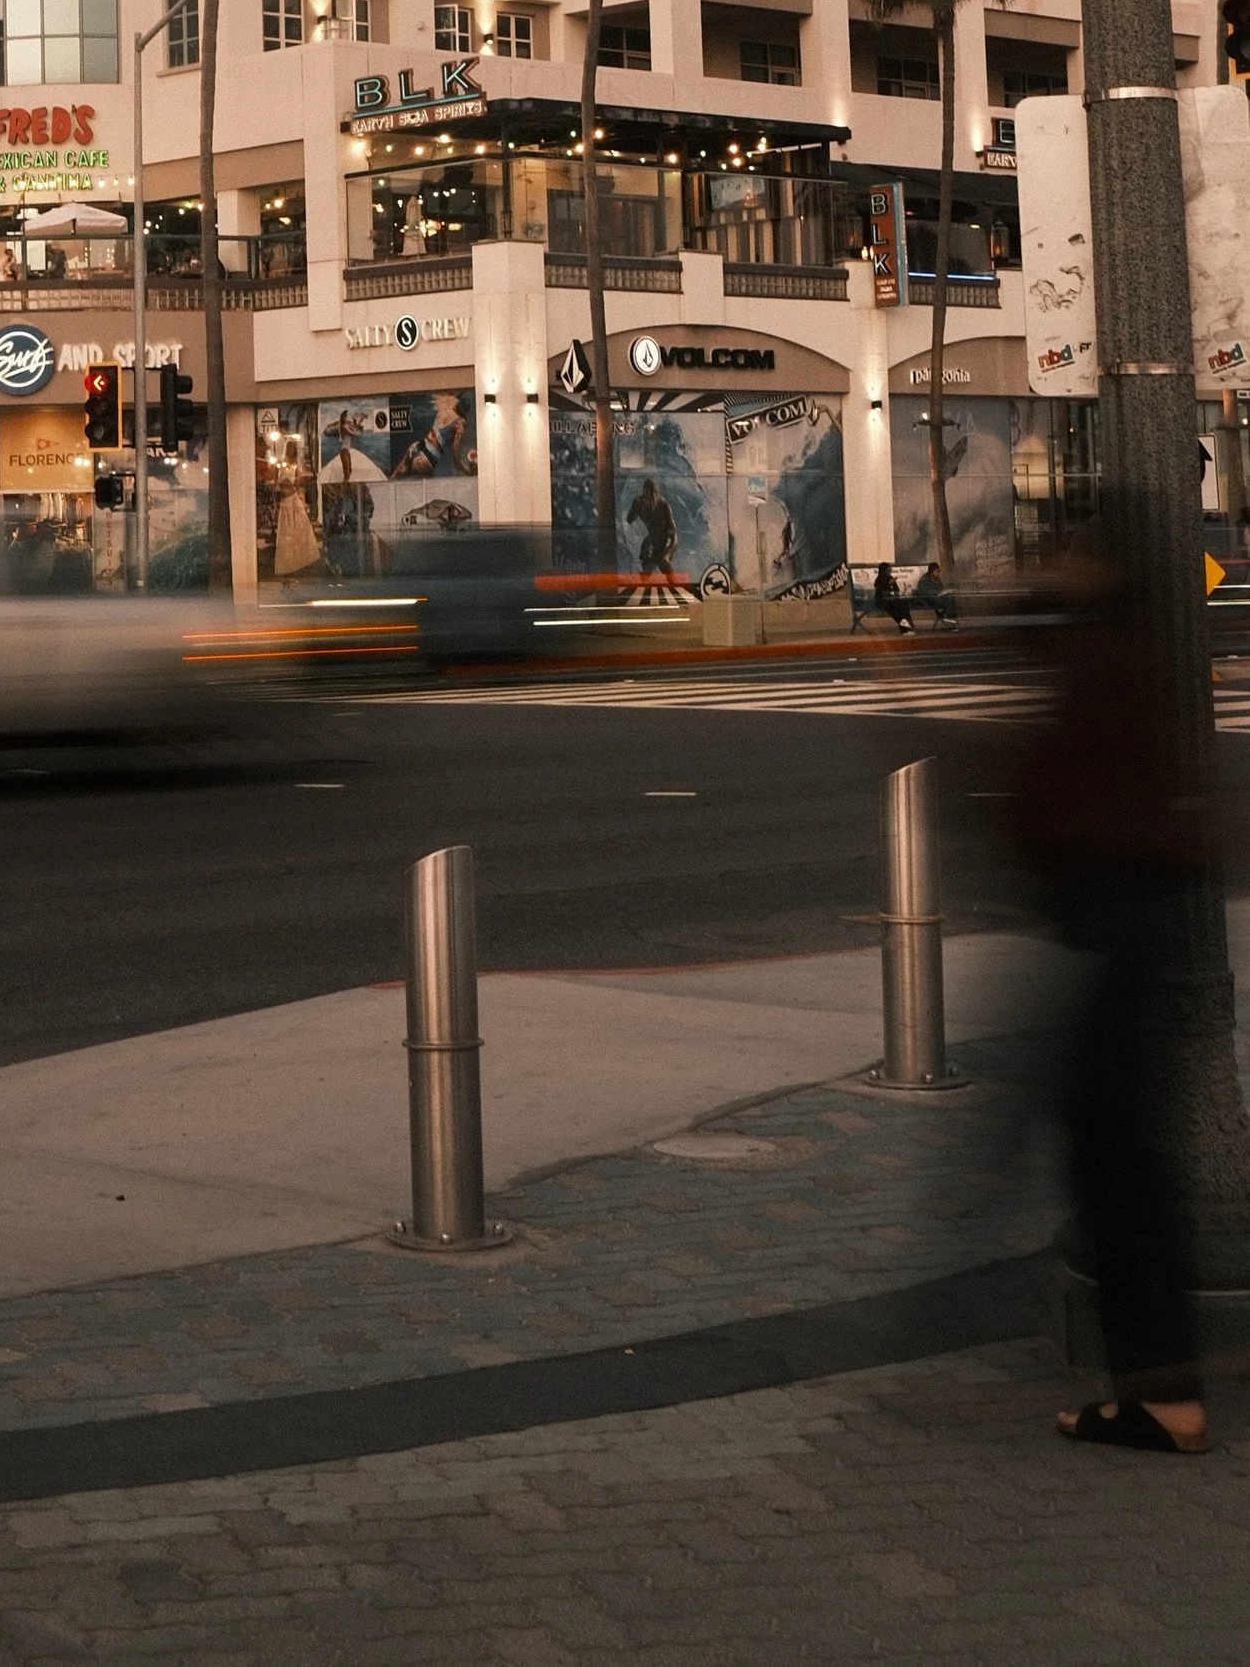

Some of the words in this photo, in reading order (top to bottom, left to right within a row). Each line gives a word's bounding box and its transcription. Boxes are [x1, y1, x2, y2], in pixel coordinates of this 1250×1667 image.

[354, 56, 482, 110] BLK
[64, 149, 110, 169] CAFE
[12, 173, 94, 192] CANTINA
[871, 193, 892, 275] BLK
[345, 324, 393, 349] SALTY
[421, 317, 470, 342] CREW
[58, 343, 104, 372] AND
[660, 346, 776, 371] VOLCOM
[1038, 344, 1073, 368] nbd
[1207, 342, 1244, 370] nbd
[910, 367, 971, 385] pagonia
